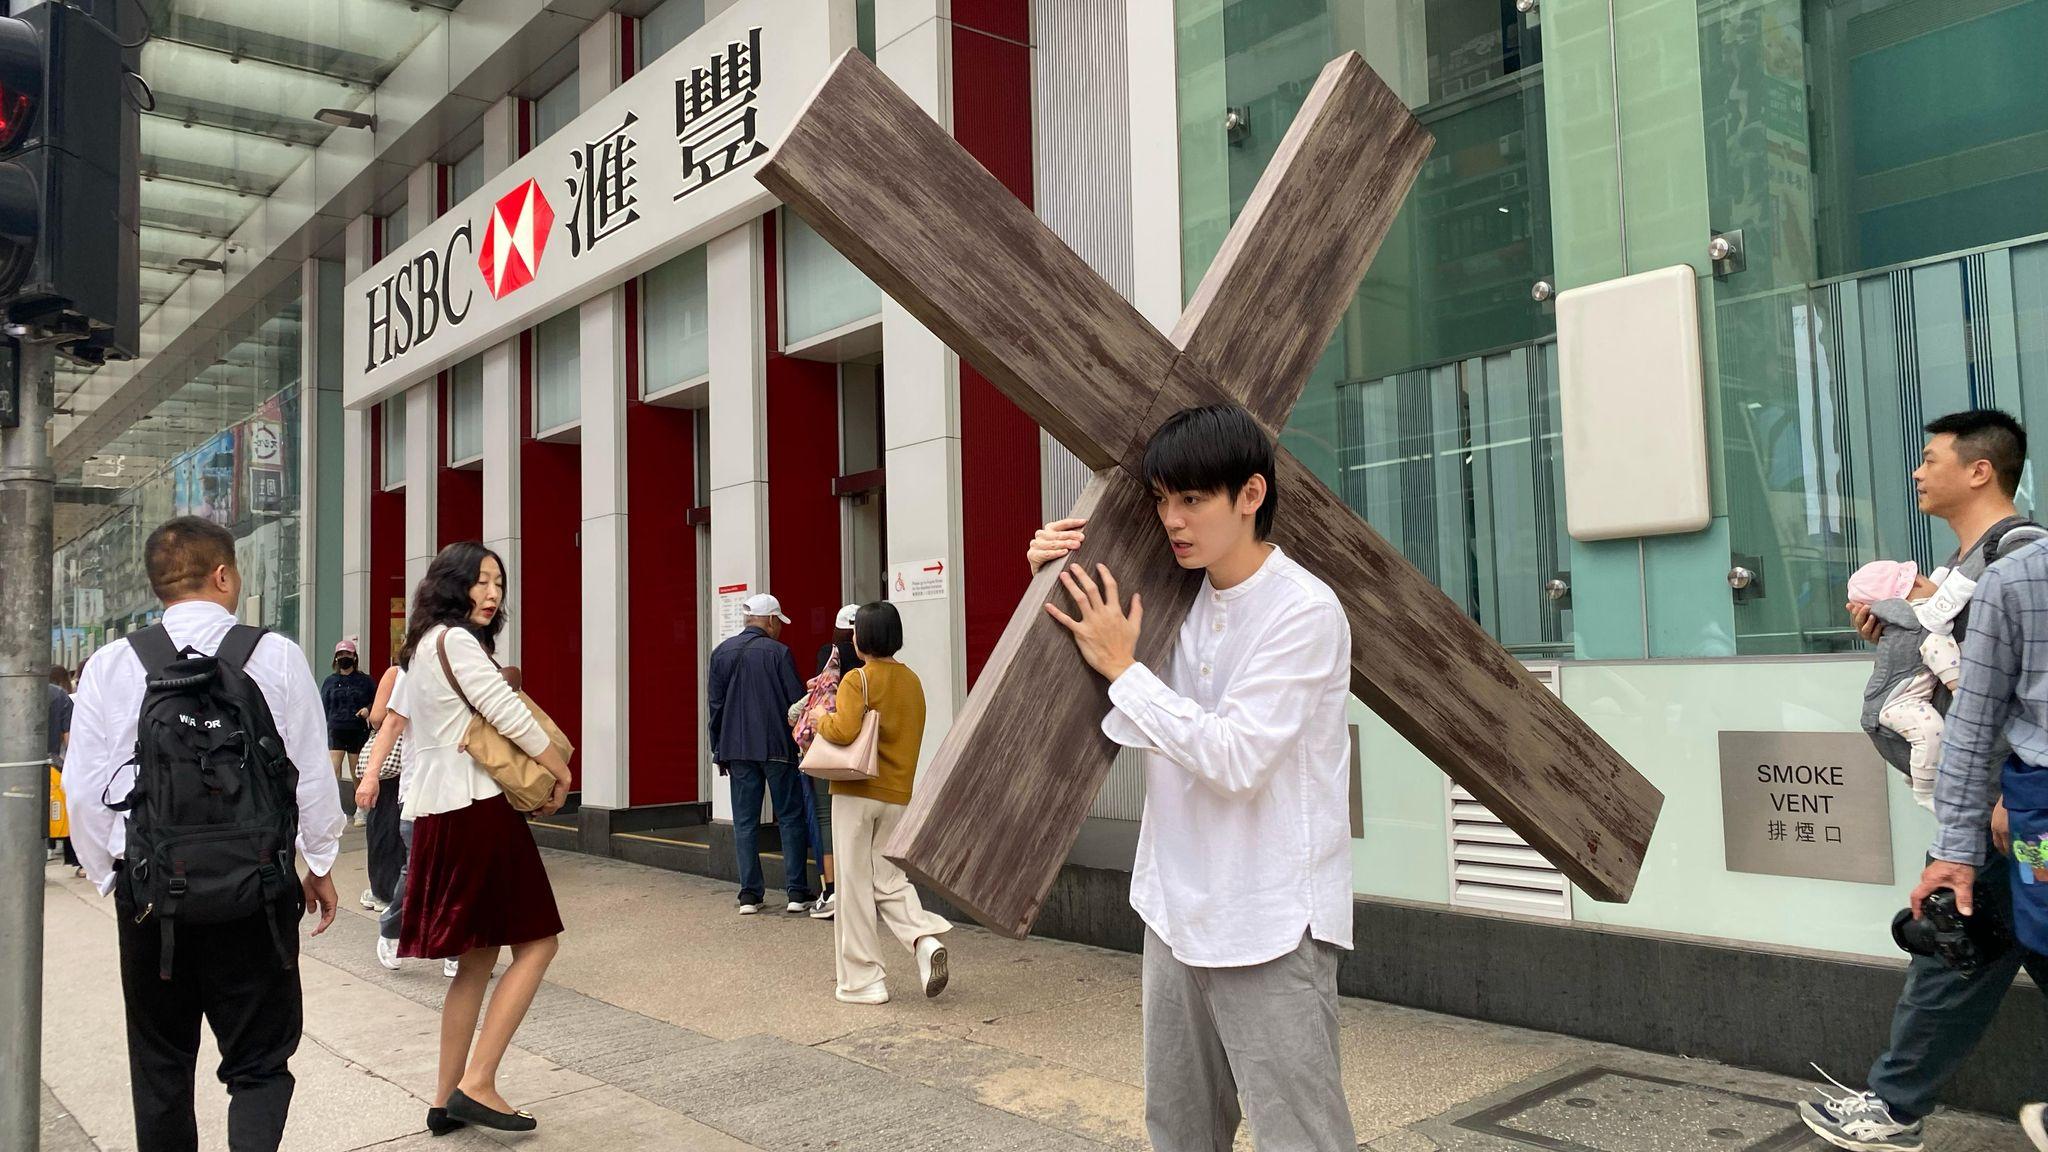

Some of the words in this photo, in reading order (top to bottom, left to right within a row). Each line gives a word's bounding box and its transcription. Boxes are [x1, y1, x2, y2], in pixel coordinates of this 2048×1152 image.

[365, 217, 473, 375] HSBC
[179, 713, 222, 729] WROR
[1757, 763, 1844, 787] SMOKE
[1769, 792, 1834, 815] VENT
[1767, 819, 1843, 844] 排煙口
